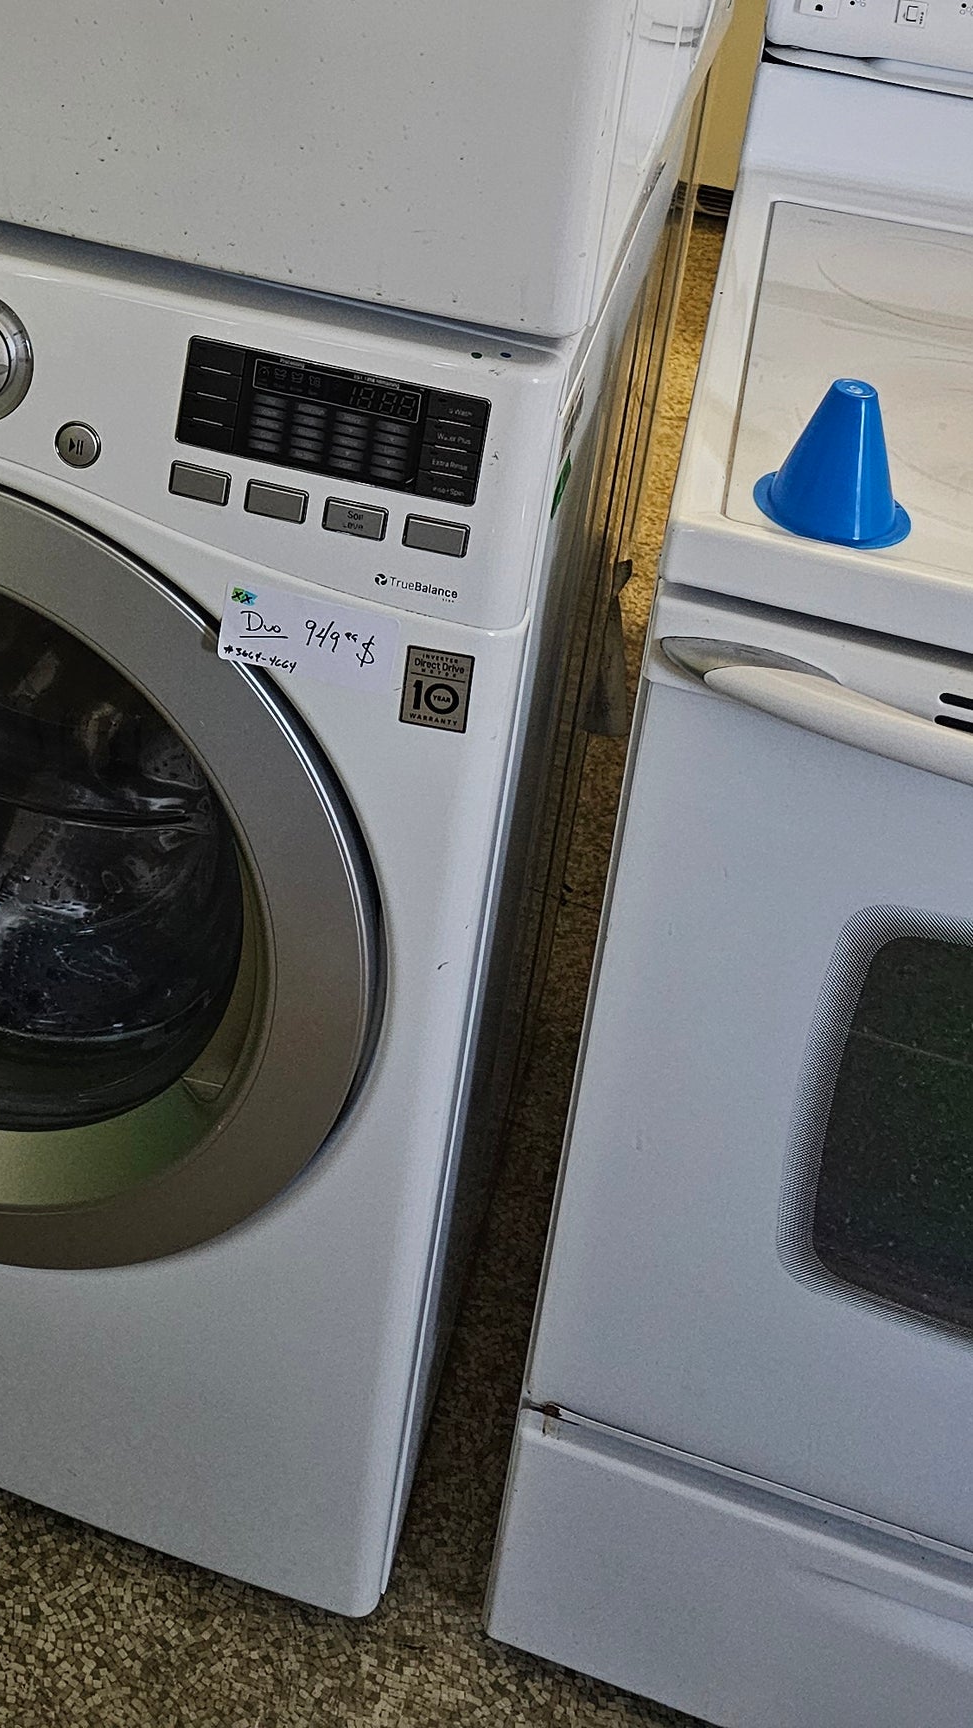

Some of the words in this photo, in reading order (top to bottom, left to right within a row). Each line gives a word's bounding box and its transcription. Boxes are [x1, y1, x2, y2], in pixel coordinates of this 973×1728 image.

[390, 576, 458, 599] TrueBalance
[240, 610, 281, 633] Duo
[305, 619, 341, 653] 949
[356, 635, 375, 668] $
[415, 658, 440, 670] Direct
[442, 663, 465, 674] Drive
[423, 654, 458, 664] INVERTER
[413, 679, 460, 715] 10
[432, 694, 451, 703] YEAR
[410, 713, 457, 726] WARRANTY
